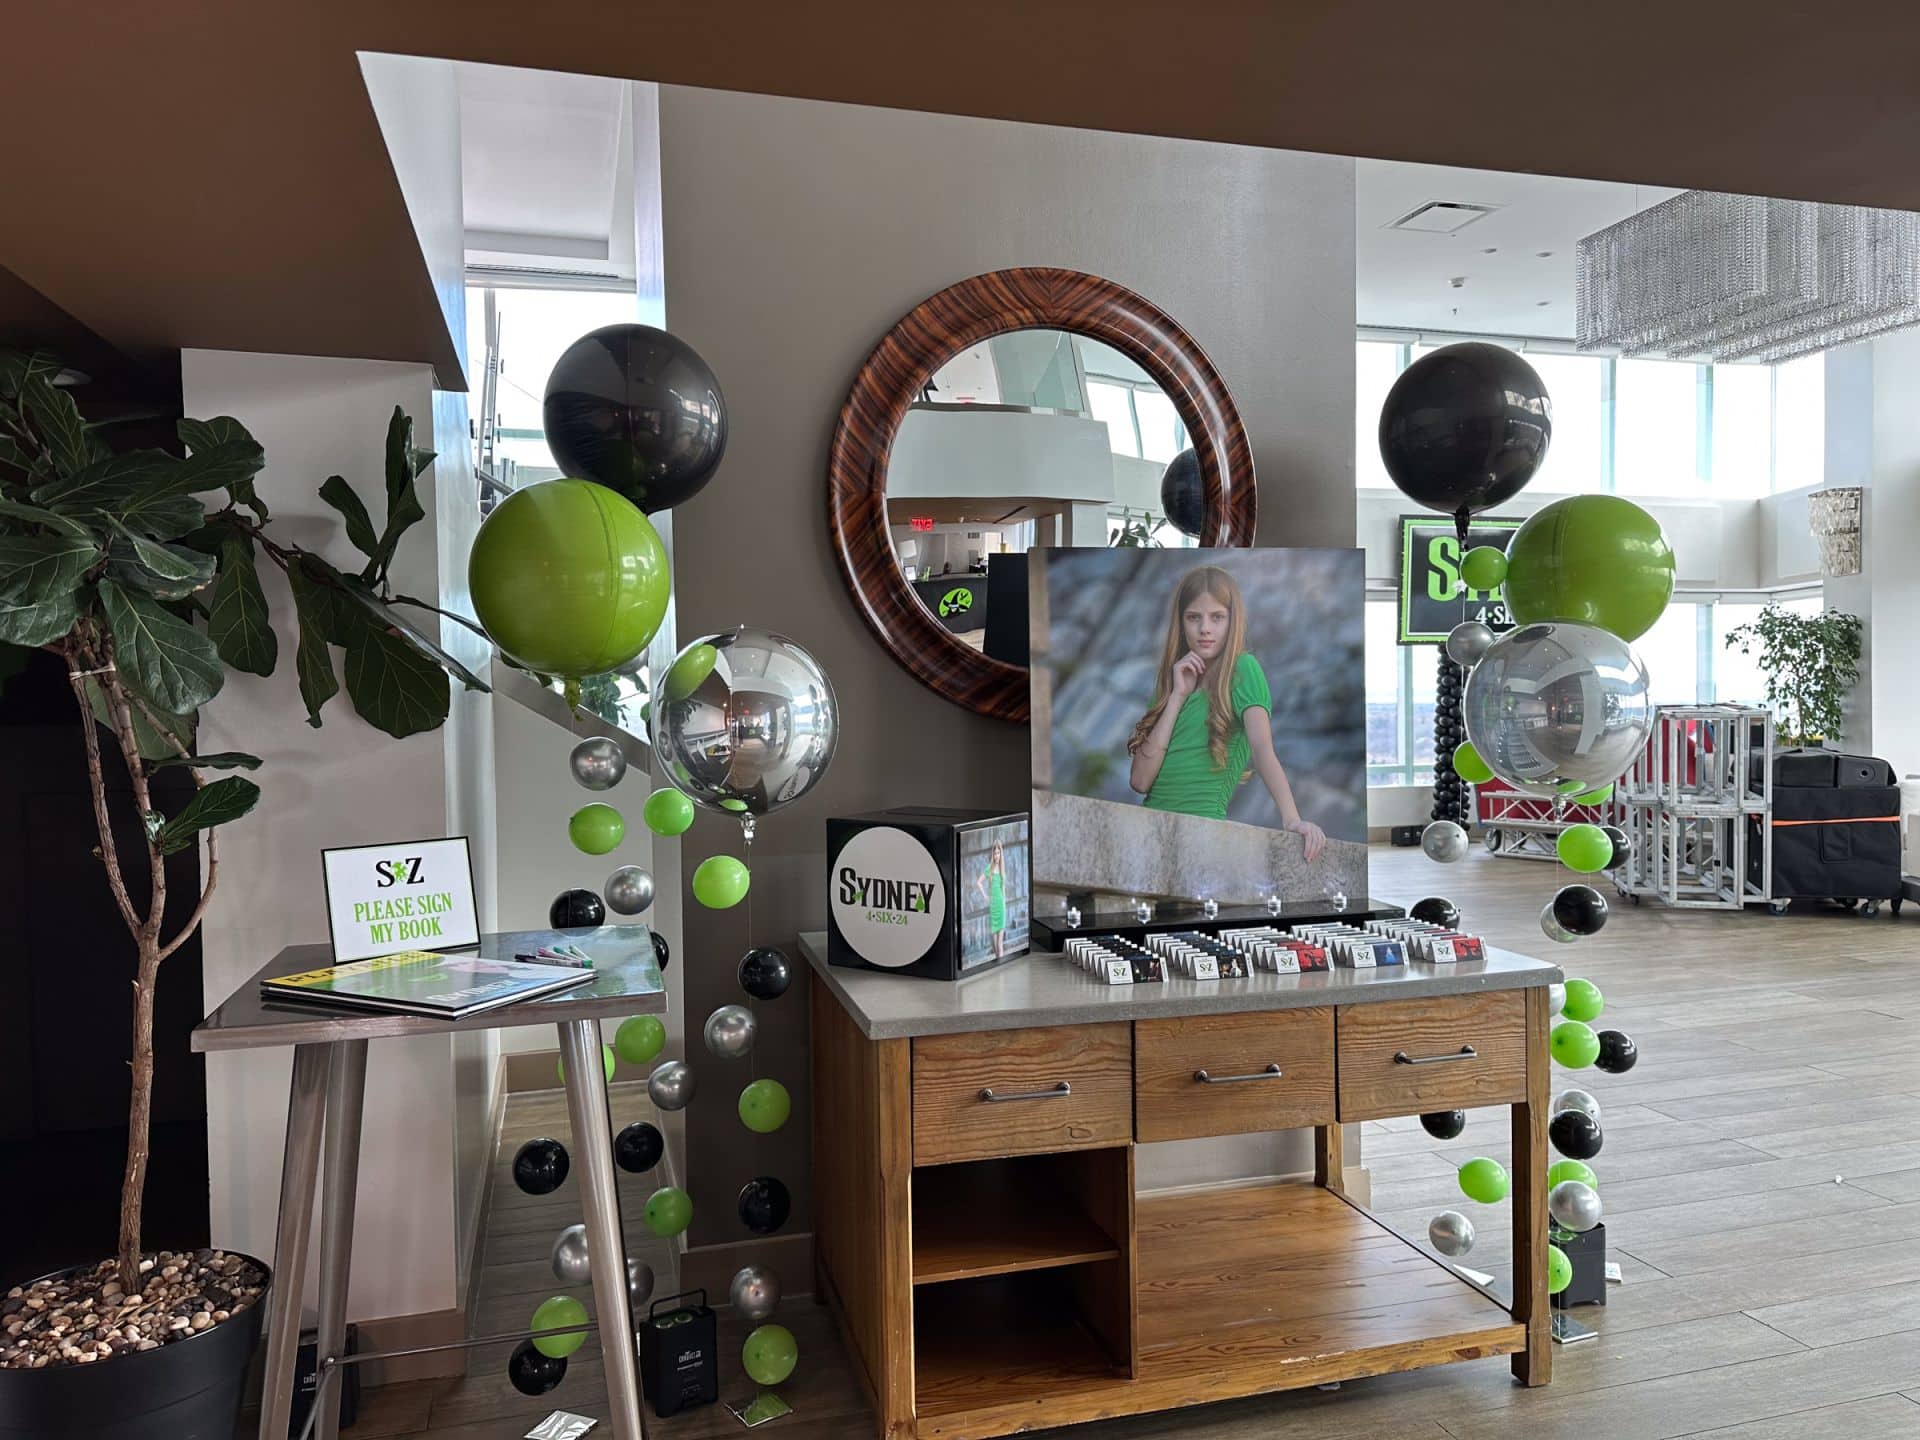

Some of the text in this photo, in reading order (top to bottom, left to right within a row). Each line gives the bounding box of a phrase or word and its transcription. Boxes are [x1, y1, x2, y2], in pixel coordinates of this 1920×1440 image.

[840, 867, 935, 914] SYDNEY
[354, 892, 452, 922] PLEASE SIGN
[370, 916, 442, 944] MY BOOK
